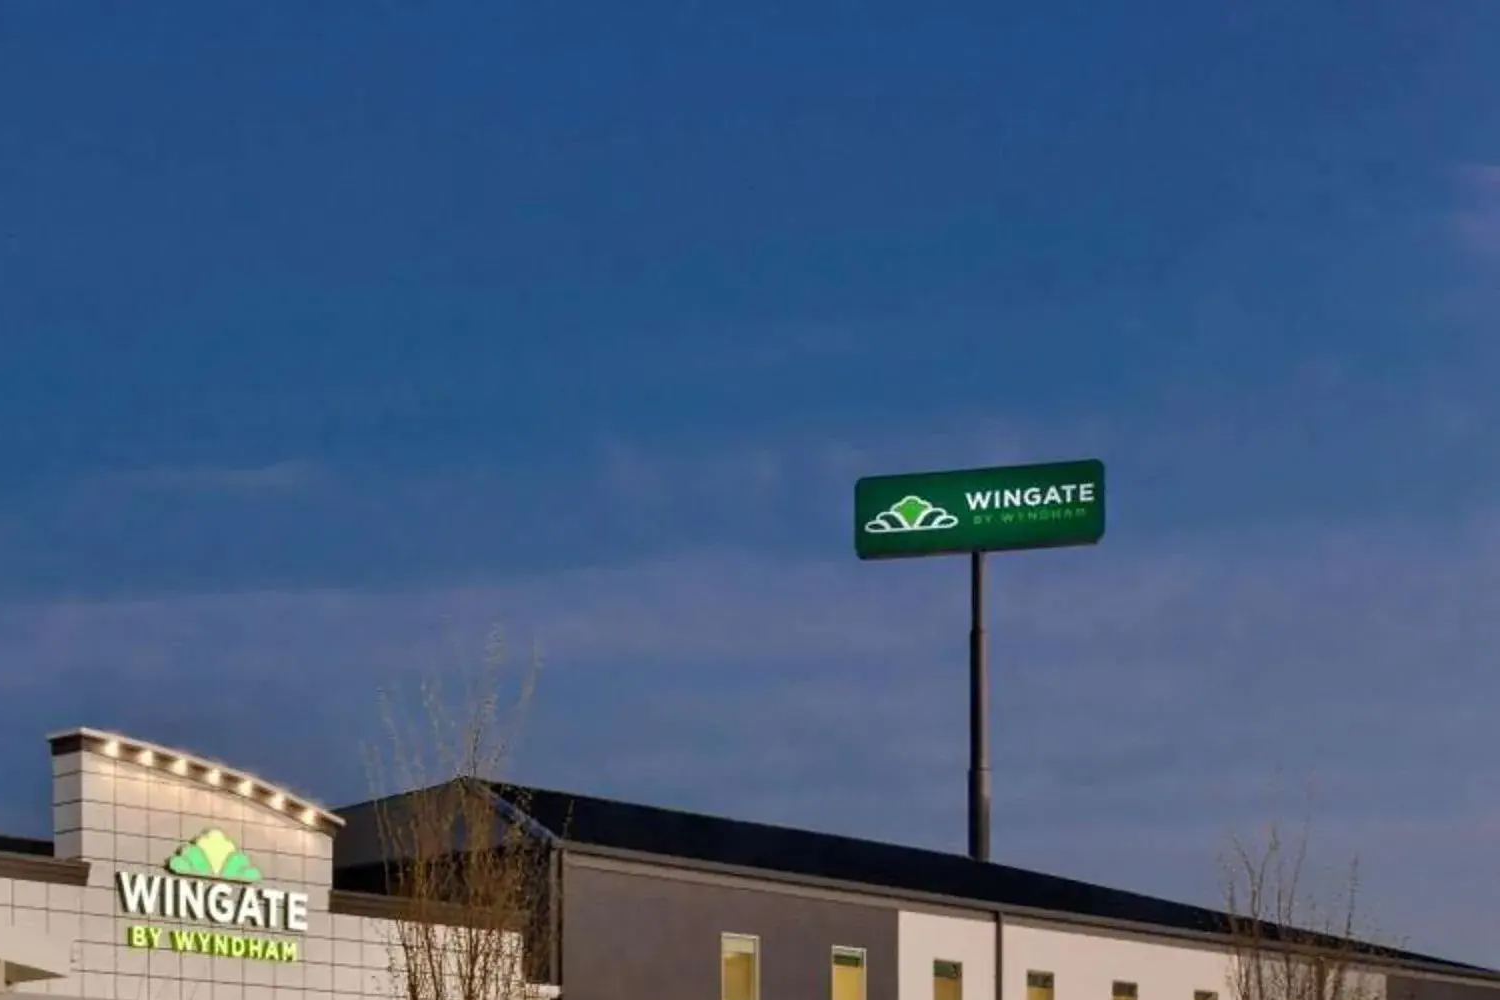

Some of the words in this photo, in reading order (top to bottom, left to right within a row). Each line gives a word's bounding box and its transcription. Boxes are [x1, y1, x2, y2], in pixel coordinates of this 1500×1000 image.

[965, 483, 1095, 511] WINGATE
[973, 515, 992, 525] BY
[1001, 507, 1088, 524] WYNDHAM
[118, 871, 308, 931] WINGATE
[130, 926, 162, 948] BY
[172, 930, 298, 962] WYNDHAM
